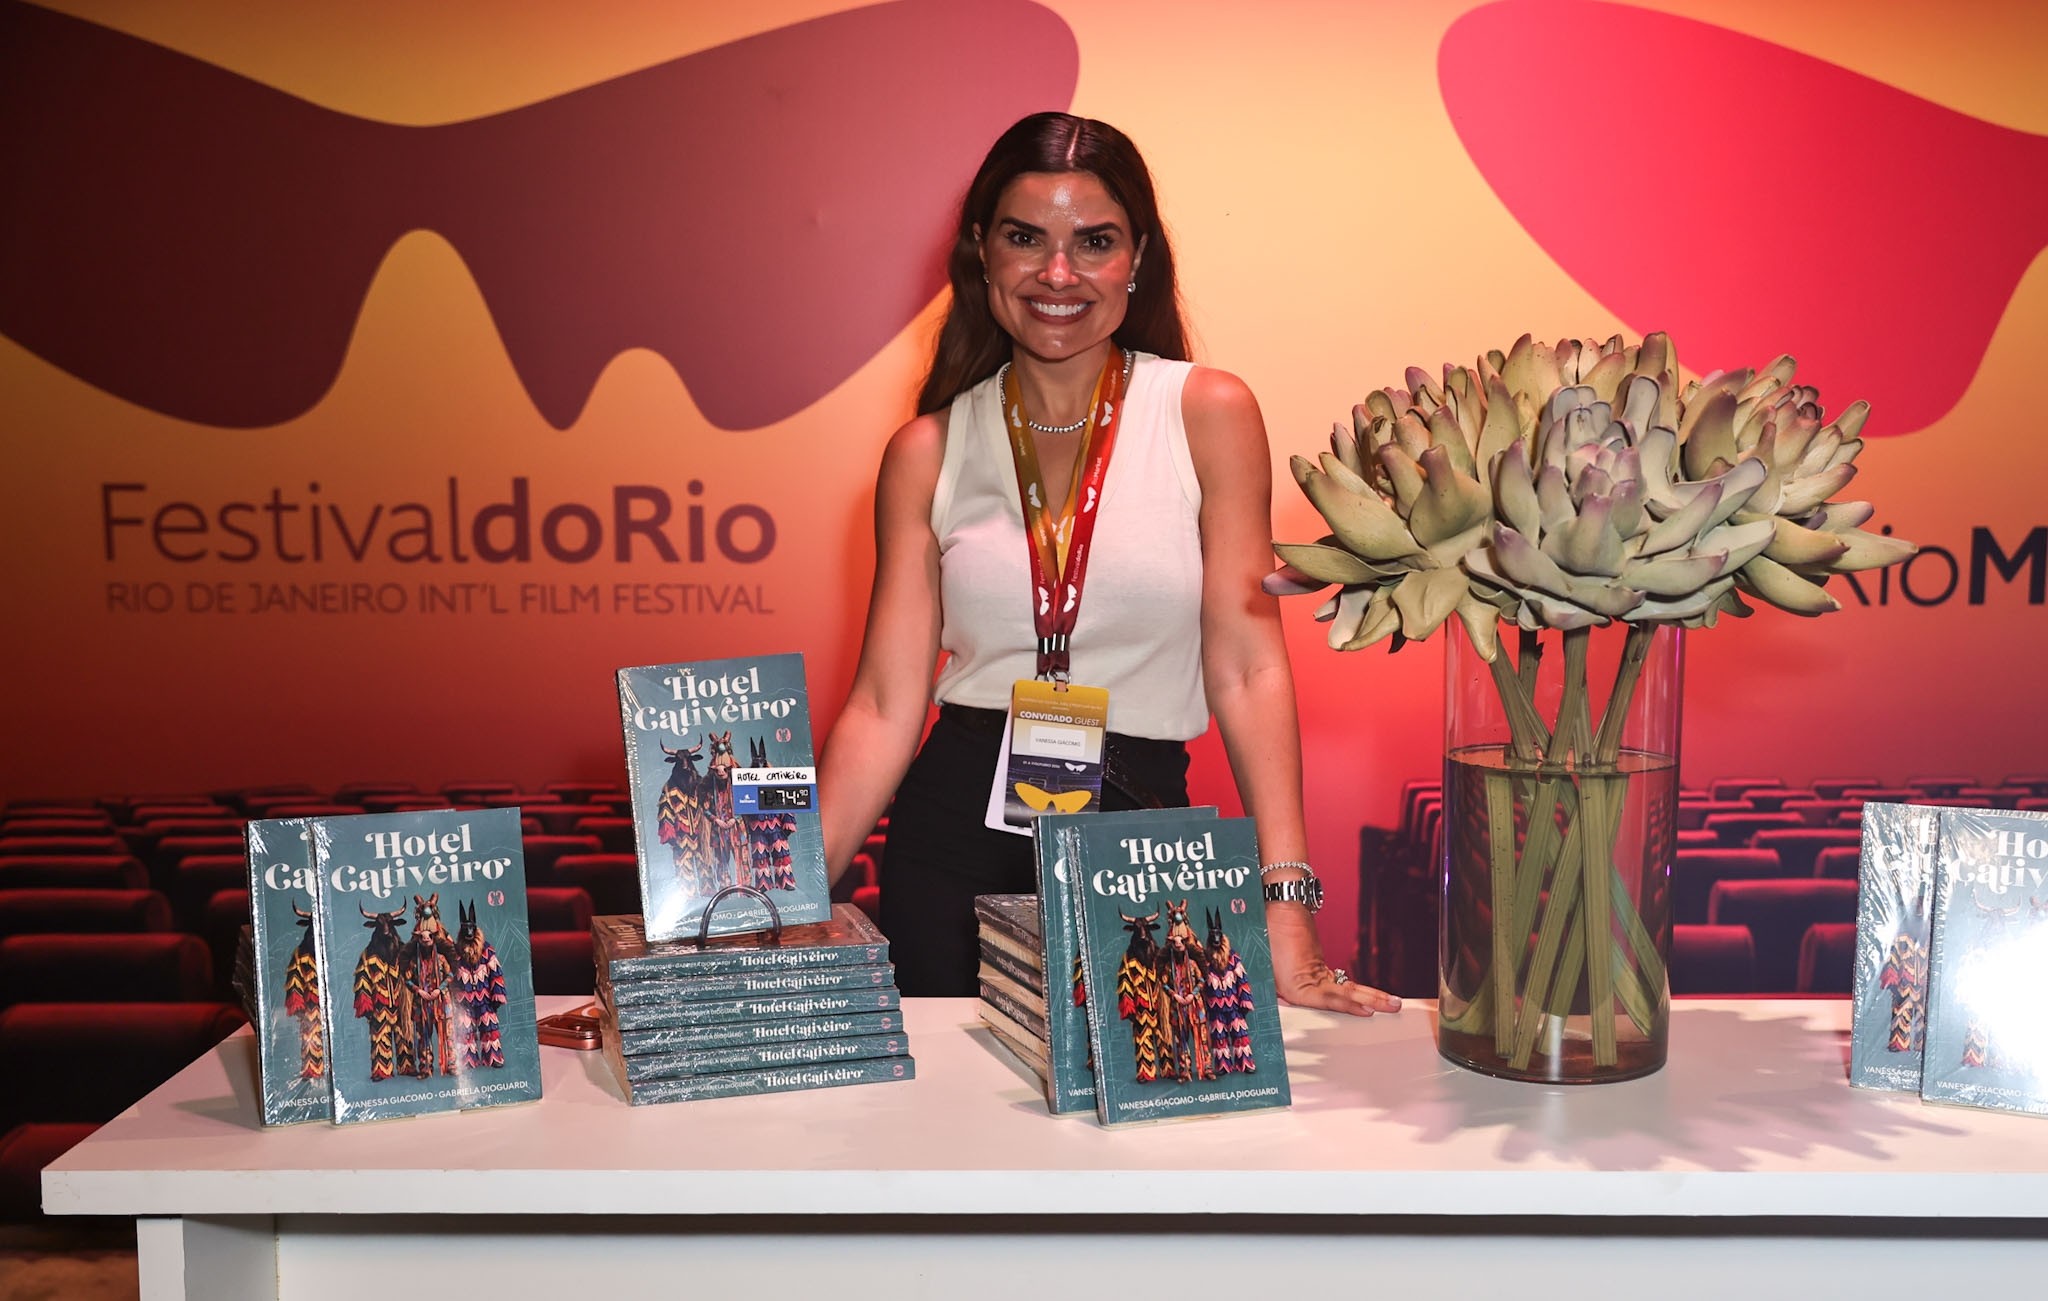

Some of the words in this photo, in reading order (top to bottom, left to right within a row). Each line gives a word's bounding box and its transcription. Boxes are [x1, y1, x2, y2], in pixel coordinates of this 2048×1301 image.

[101, 476, 777, 565] FestivaldoRio
[107, 583, 174, 615] RIO
[187, 583, 236, 614] DE
[248, 583, 408, 615] JANEIRO
[420, 583, 509, 614] INT'L
[520, 583, 600, 614] FILM
[613, 583, 775, 614] FESTIVAL
[664, 667, 760, 701] Hotel
[634, 695, 797, 736] Cativeiro
[1020, 711, 1073, 723] CONVIDADO
[1074, 717, 1100, 726] GUEST
[737, 772, 760, 781] HOTEL
[365, 823, 473, 859] Hotel
[1120, 831, 1216, 865] Hotel
[331, 854, 511, 899] Cativeiro
[1092, 863, 1250, 903] Cativeiro
[737, 908, 772, 919] GABRIEL
[740, 953, 777, 966] Hotel
[777, 951, 839, 966] Cativeiro
[744, 978, 782, 990] Hotel
[782, 975, 843, 989] Cativeiro
[750, 1001, 787, 1014] Hotel
[787, 998, 848, 1013] Cativeiro
[753, 1025, 791, 1038] Hotel
[791, 1021, 851, 1036] Cativeiro
[759, 1048, 797, 1062] Hotel
[797, 1044, 858, 1060] Cativeiro
[764, 1072, 802, 1086] Hotel
[803, 1069, 863, 1085] Cativeiro
[278, 1097, 319, 1109] VANESSA
[350, 1099, 388, 1109] VANESSA
[390, 1093, 434, 1105] GIACOMO
[439, 1087, 480, 1098] GABRIELA
[481, 1081, 528, 1094] DIOGUARDI
[1119, 1100, 1153, 1110] VANESSA
[1154, 1095, 1194, 1106] GIACOMO
[1199, 1091, 1236, 1102] GABRIELA
[1236, 1087, 1279, 1099] DIOGUARDI
